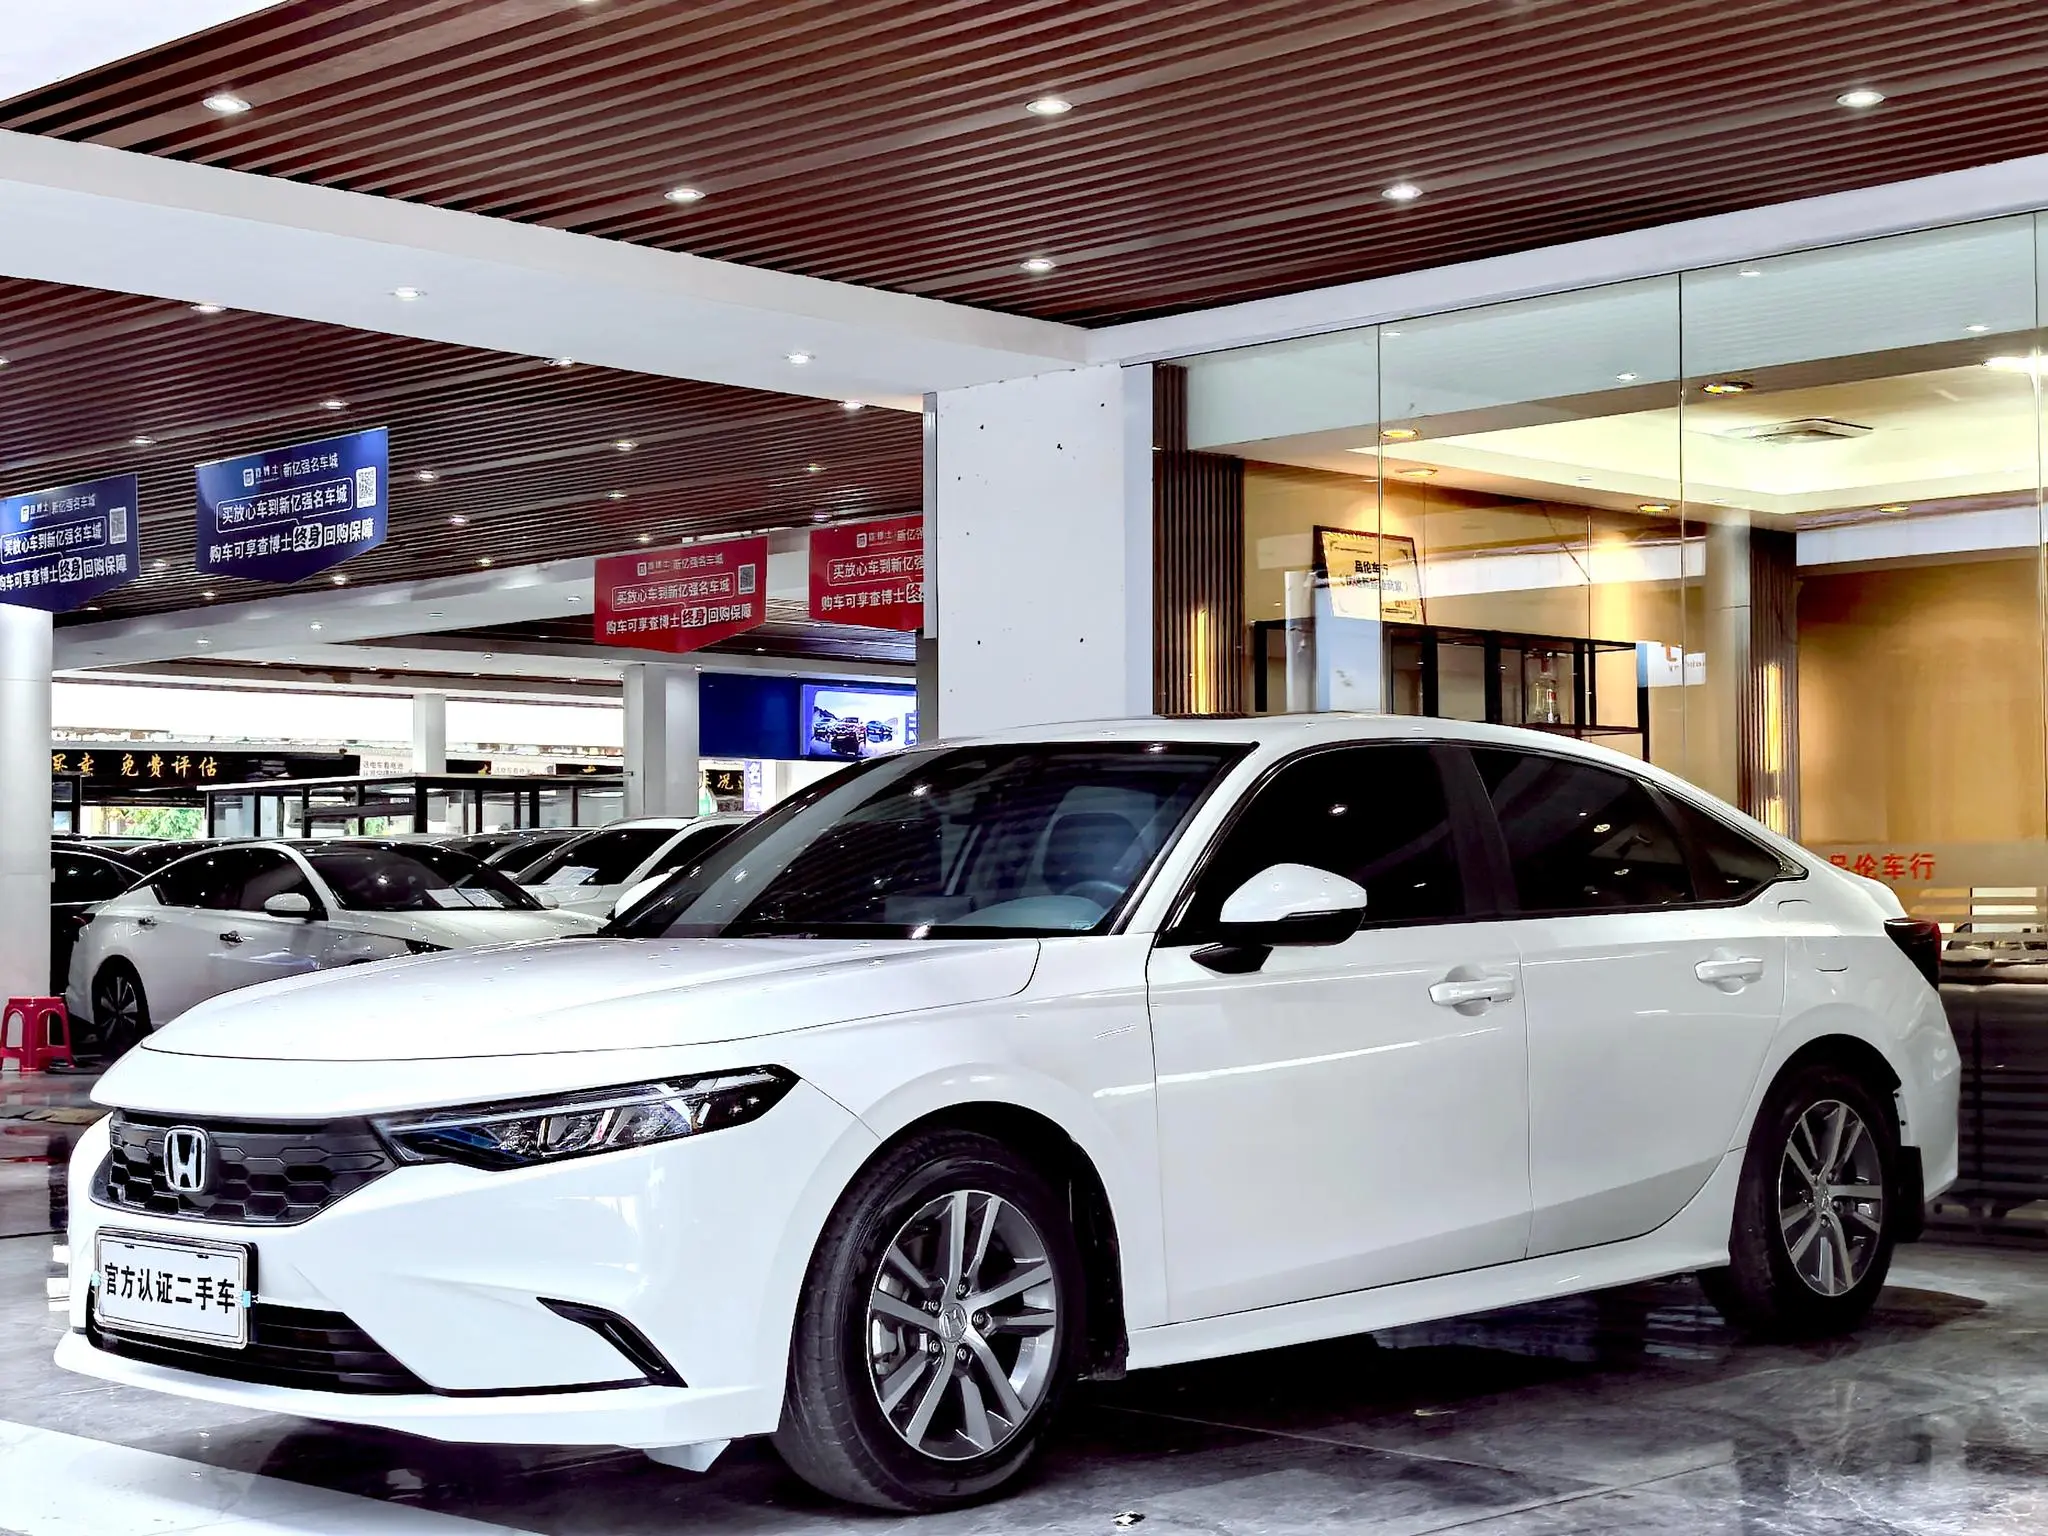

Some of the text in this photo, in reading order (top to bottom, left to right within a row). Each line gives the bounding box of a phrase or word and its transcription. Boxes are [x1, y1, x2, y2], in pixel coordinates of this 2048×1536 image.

[283, 452, 339, 478] 新亿强名车城
[222, 484, 348, 525] 买放心车到新亿强名车城
[4, 521, 102, 557] 买放心车到新亿强名车城
[209, 517, 375, 564] 购车可享查博士终身回购保障
[616, 577, 731, 606] 买放心车到新亿强名车城
[821, 583, 925, 611] 购车可享查博士终
[605, 602, 753, 636] 购车可享查博士终身回购保障
[120, 753, 217, 779] 免费评估
[104, 1262, 236, 1314] 官方认证二手车
